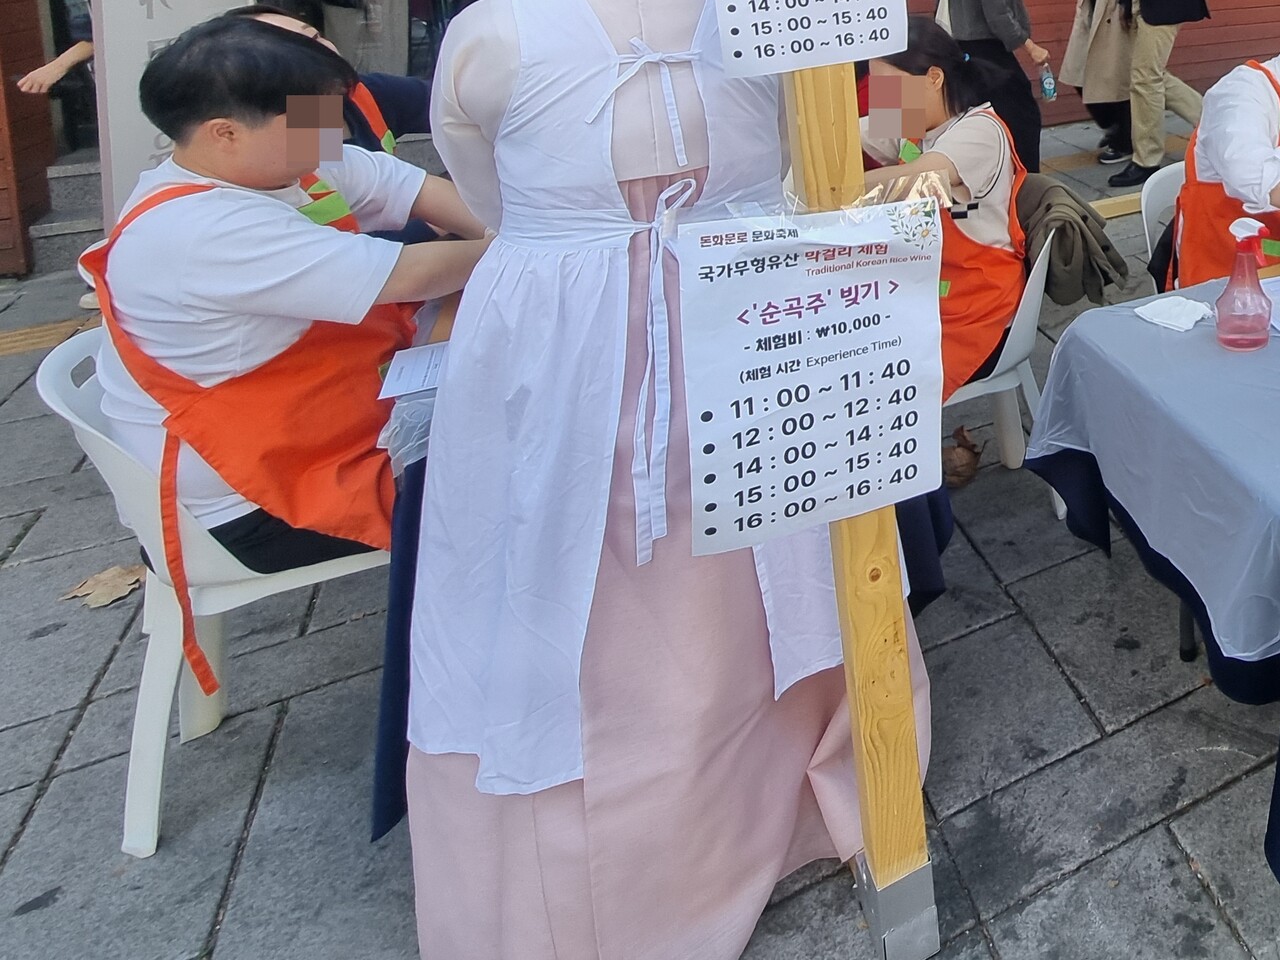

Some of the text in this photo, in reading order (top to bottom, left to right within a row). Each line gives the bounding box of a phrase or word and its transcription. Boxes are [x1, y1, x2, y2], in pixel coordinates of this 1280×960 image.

[700, 228, 799, 248] 돈화문로 문화축제
[698, 253, 799, 283] 국가무형유산
[805, 246, 852, 263] 막걸리
[806, 261, 854, 277] Traditional
[856, 257, 888, 268] Korean
[840, 281, 880, 308] 빚기
[756, 330, 802, 352] 체험비
[776, 359, 801, 375] 시간
[806, 345, 869, 368] Experience
[871, 336, 902, 352] Time)
